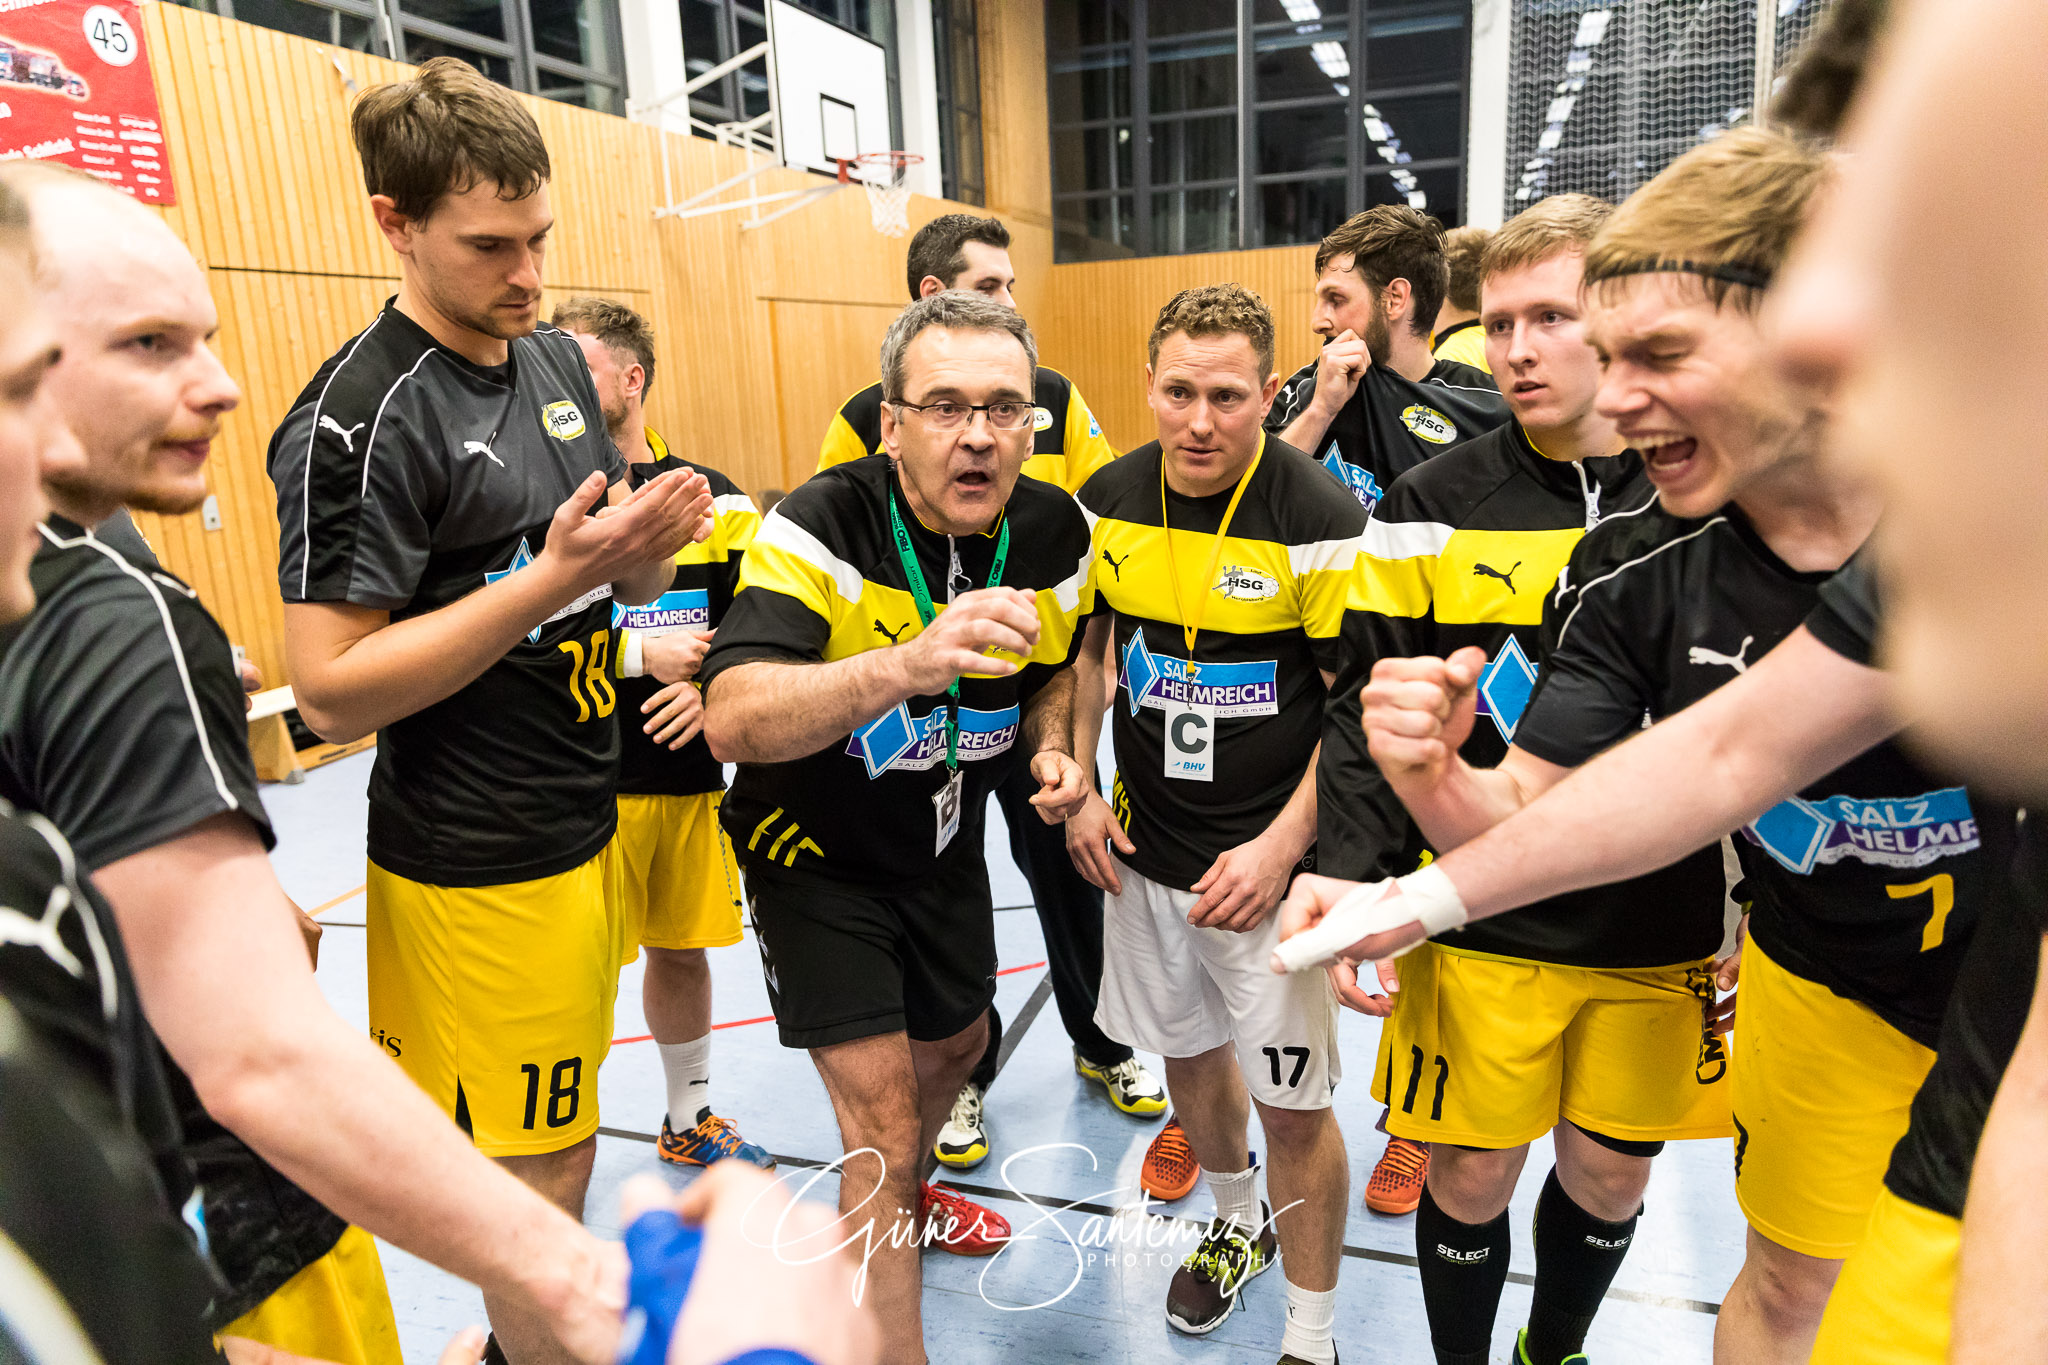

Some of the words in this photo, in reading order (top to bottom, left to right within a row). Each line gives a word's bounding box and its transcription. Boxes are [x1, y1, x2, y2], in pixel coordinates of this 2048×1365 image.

[93, 18, 128, 53] 45
[550, 411, 578, 427] HSG
[1415, 415, 1445, 434] HSG
[1351, 469, 1377, 497] SAL
[897, 529, 911, 553] FIBO
[991, 558, 1003, 581] FIBO
[1227, 577, 1264, 591] HSG
[627, 607, 708, 628] HELMREICH
[558, 628, 616, 723] 18
[1164, 660, 1203, 684] SALZ
[1161, 678, 1271, 705] HELMREICH
[1171, 713, 1208, 754] C
[1183, 761, 1206, 771] BHV
[1838, 801, 1935, 828] SALZ
[1885, 873, 1954, 952] 7
[1262, 1046, 1310, 1088] 17
[521, 1056, 582, 1130] 18
[1402, 1043, 1449, 1121] 11
[1437, 1243, 1491, 1261] SELECT
